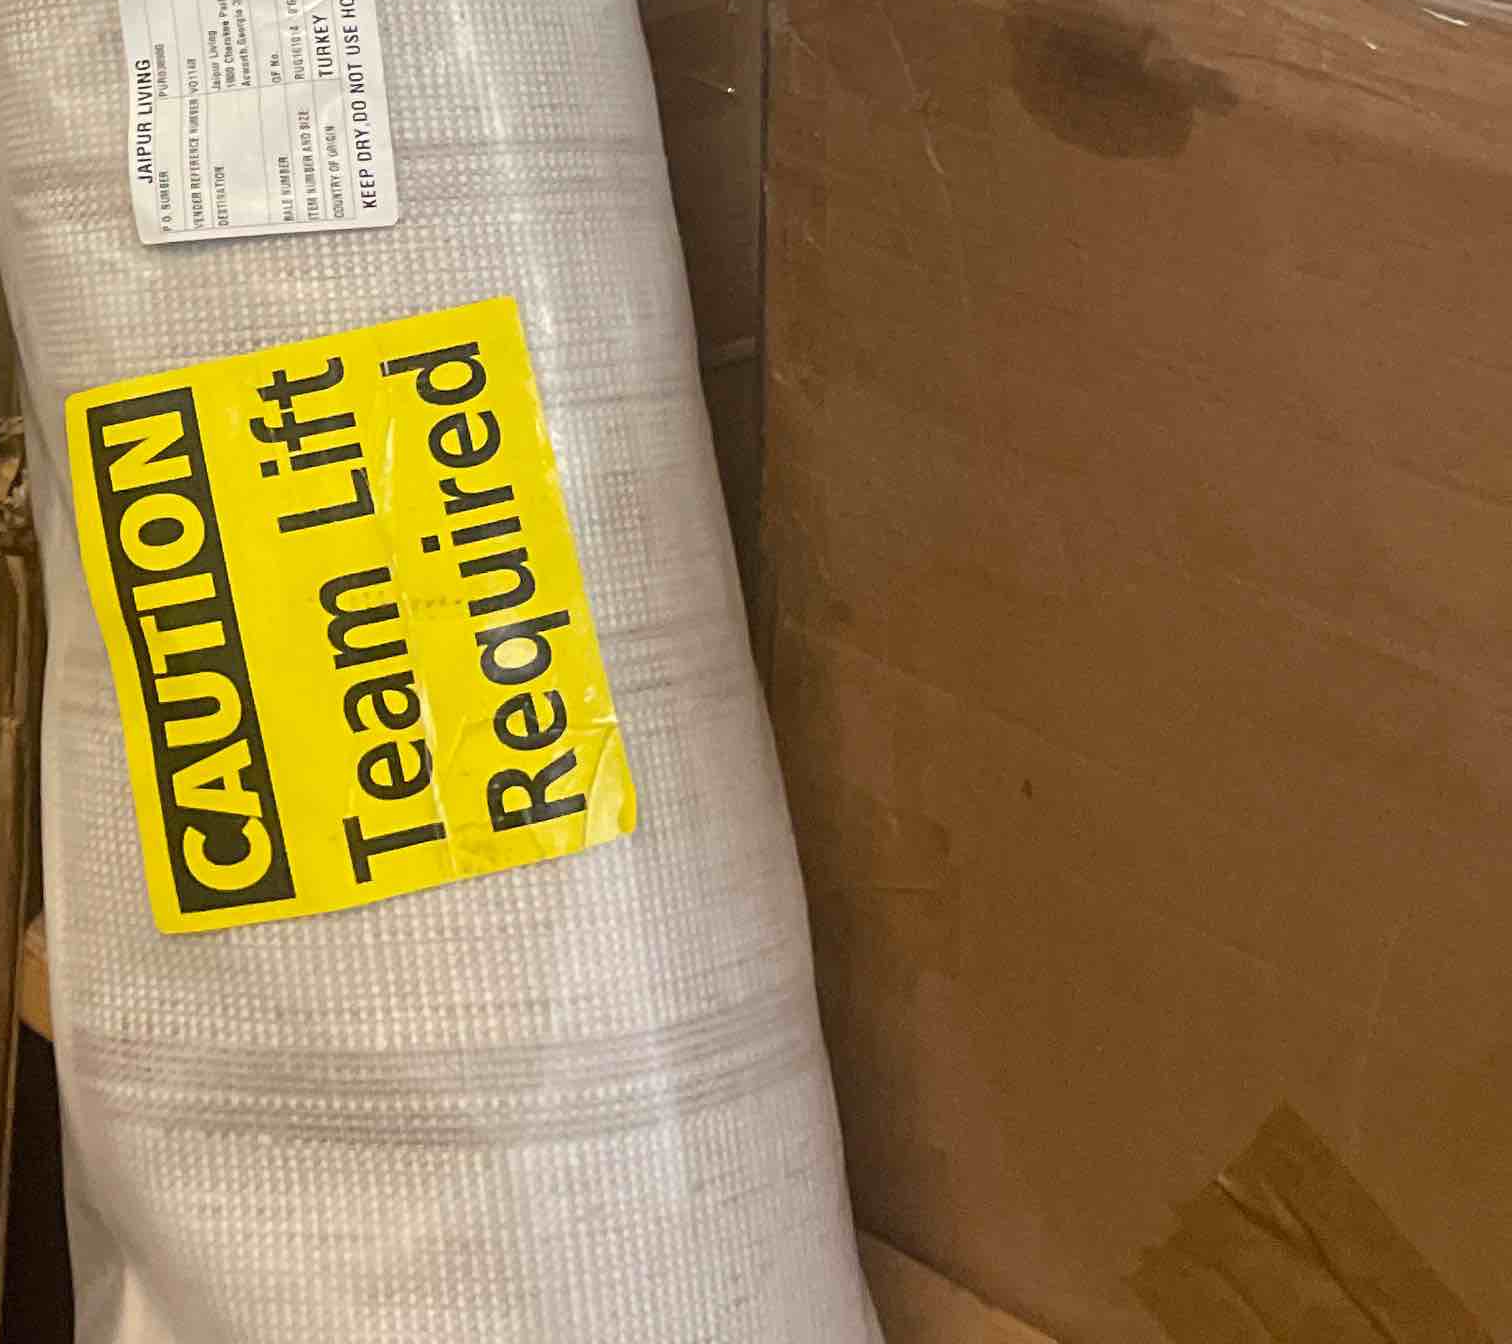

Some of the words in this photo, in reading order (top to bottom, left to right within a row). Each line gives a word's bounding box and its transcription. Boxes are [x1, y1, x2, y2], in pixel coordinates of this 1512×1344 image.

[311, 14, 334, 78] TURKEY
[343, 24, 360, 55] USE
[135, 59, 153, 116] LIVING
[348, 63, 365, 93] NOT
[136, 122, 153, 184] JAIPUR
[331, 174, 346, 219] COUNTRY
[359, 168, 377, 209] KEEP
[249, 356, 375, 534] Lift
[380, 341, 587, 833] Required
[102, 410, 273, 892] CAUTION
[319, 567, 447, 884] Team
